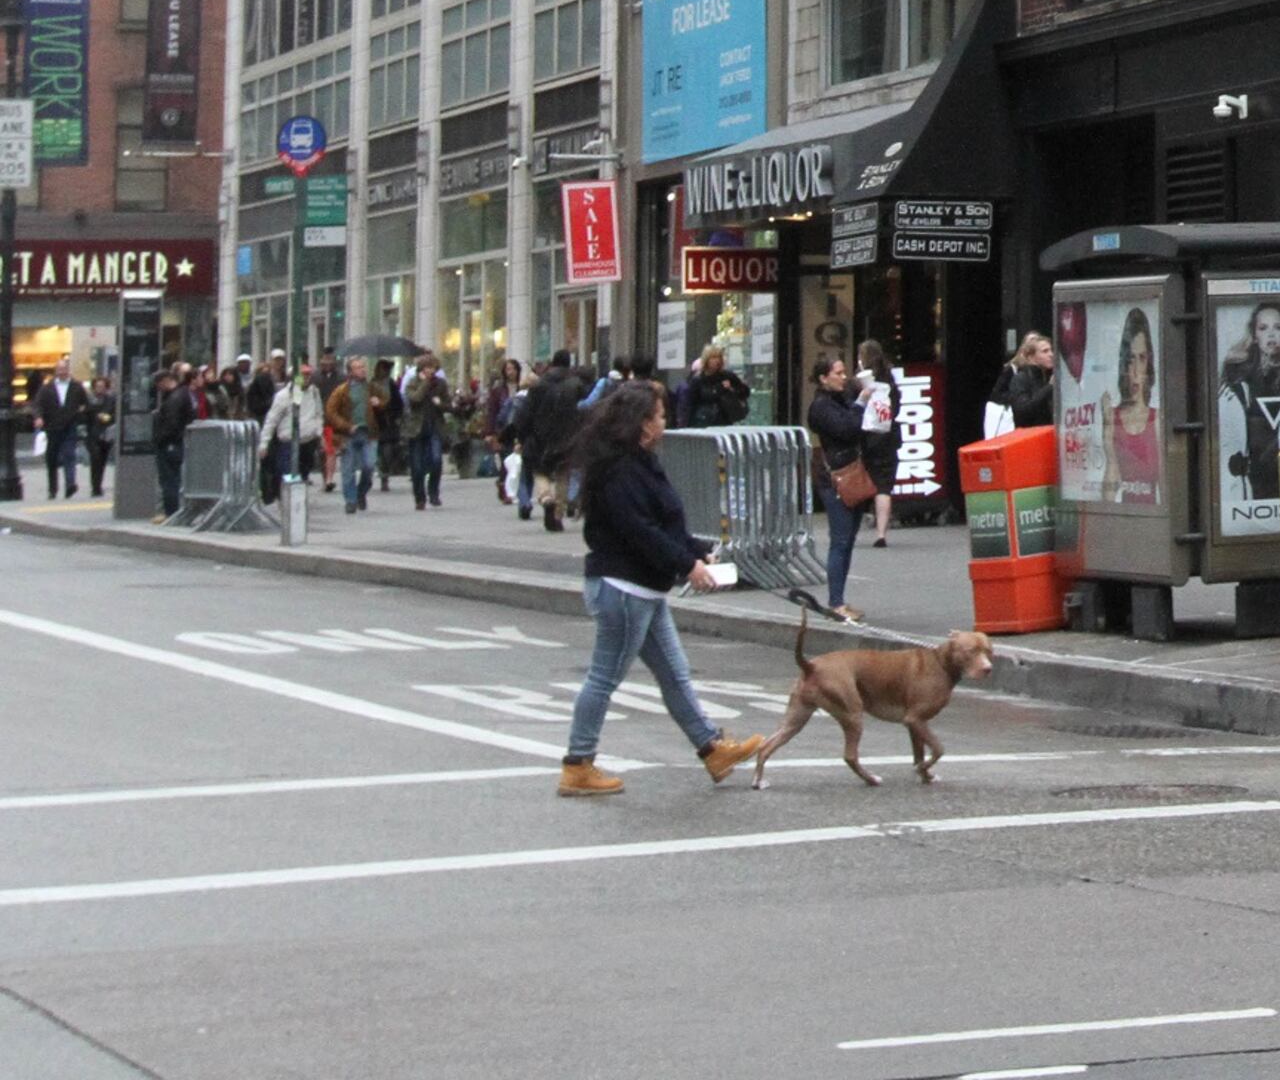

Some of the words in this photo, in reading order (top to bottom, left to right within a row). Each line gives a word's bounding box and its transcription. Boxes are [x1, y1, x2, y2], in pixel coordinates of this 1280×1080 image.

[166, 14, 180, 58] LEASE
[672, 3, 696, 36] FOR
[29, 14, 83, 118] WORK
[686, 161, 735, 215] WINE
[751, 148, 825, 208] LIQUOR
[582, 189, 601, 260] SALE
[898, 203, 951, 216] STANLEY
[954, 206, 963, 216] &
[896, 238, 926, 252] CASH
[928, 239, 963, 253] DEPOT
[965, 240, 988, 254] INC.
[39, 253, 57, 285] A
[67, 251, 169, 285] MANGER
[686, 255, 779, 284] LIQUOR
[890, 367, 936, 480] LIQUOR
[969, 512, 1006, 530] metro
[175, 625, 569, 655] ONLY
